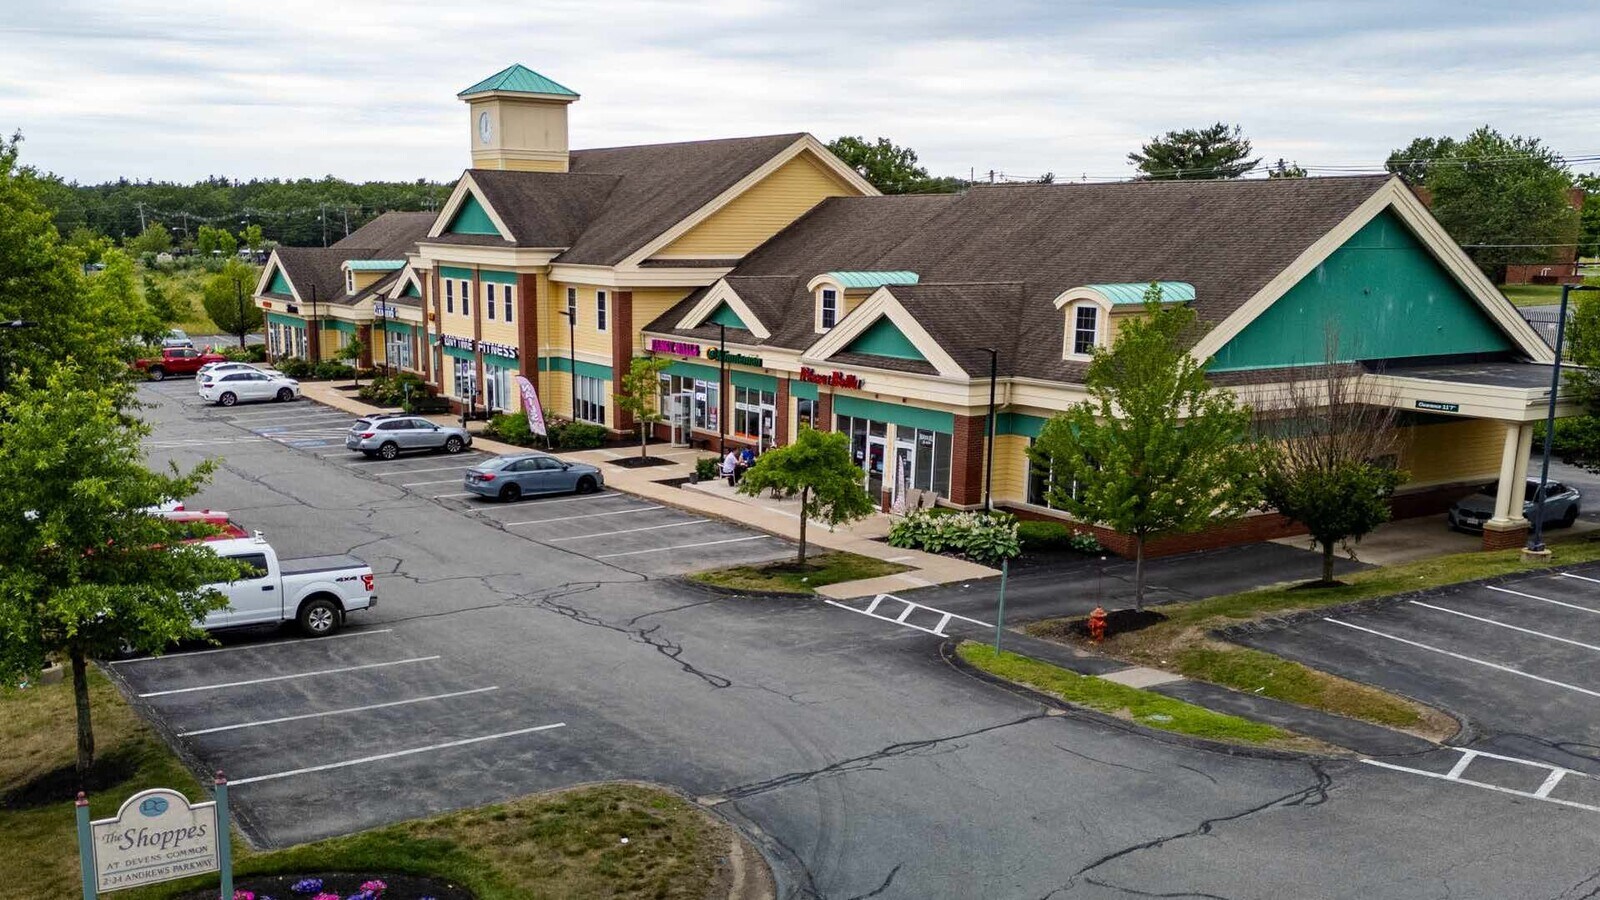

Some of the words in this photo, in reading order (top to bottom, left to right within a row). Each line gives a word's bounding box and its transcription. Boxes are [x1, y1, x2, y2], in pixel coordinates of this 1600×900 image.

[478, 341, 516, 358] FITNESS
[102, 832, 123, 844] The
[119, 825, 207, 850] Shoppes
[107, 862, 120, 871] AT
[125, 853, 162, 867] DEVENS
[166, 845, 208, 860] COMMON
[126, 867, 170, 881] ANDREWS
[173, 860, 214, 872] PARKWAY
